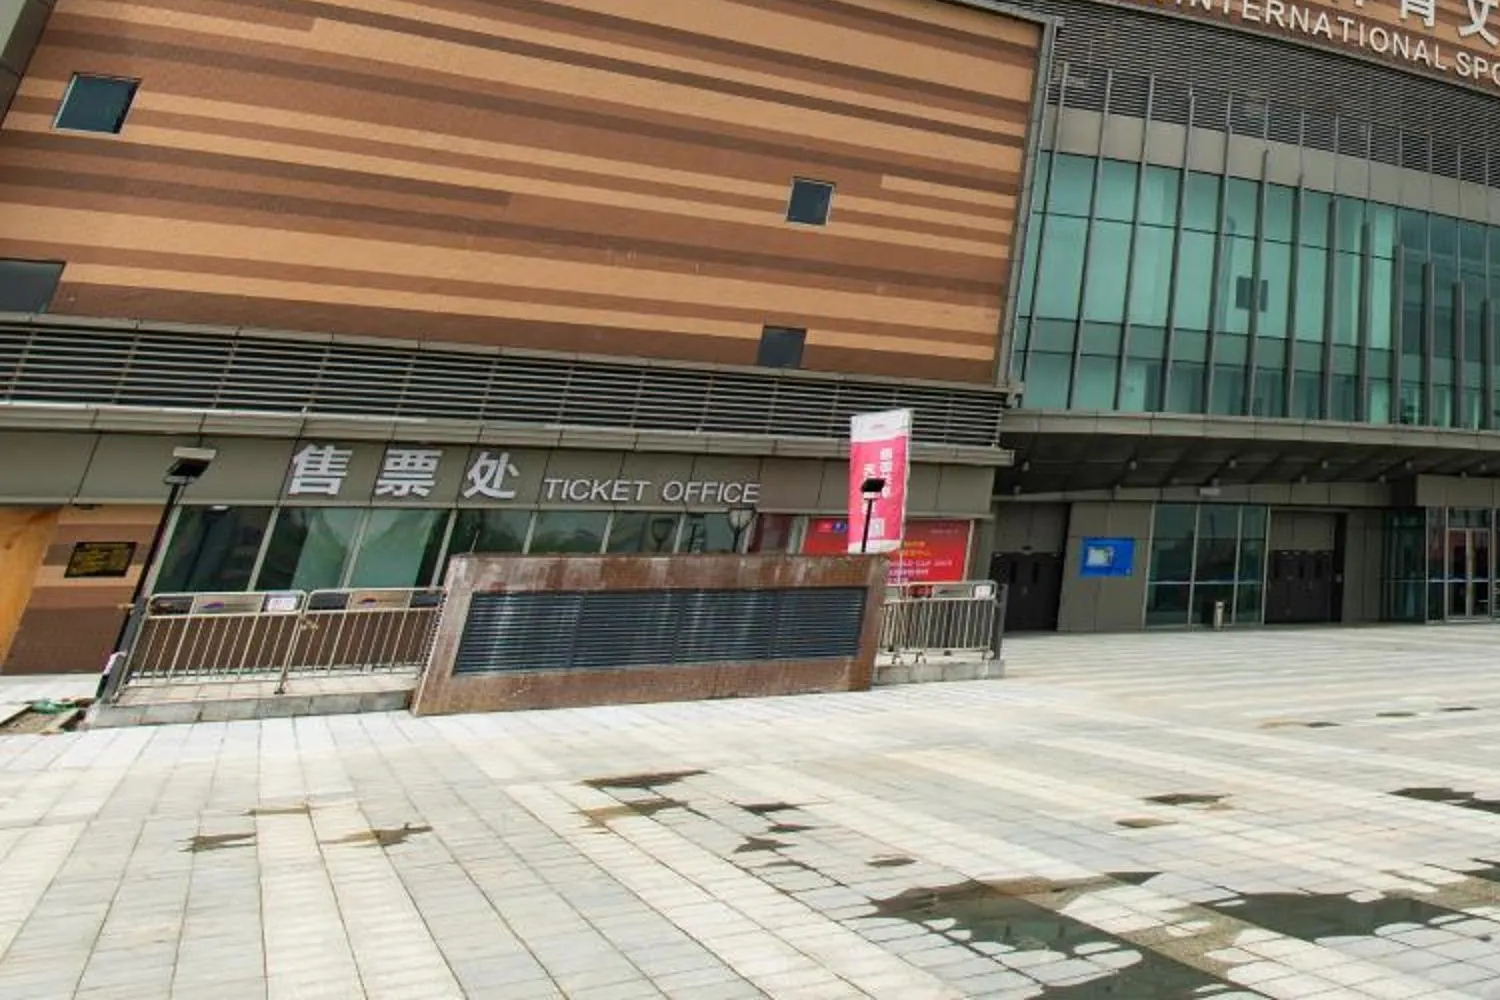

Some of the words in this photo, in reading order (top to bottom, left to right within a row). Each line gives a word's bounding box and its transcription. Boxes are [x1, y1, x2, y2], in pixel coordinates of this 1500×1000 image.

[288, 444, 520, 499] 售票处
[545, 478, 650, 502] TICKET
[662, 480, 761, 504] OFFICE
